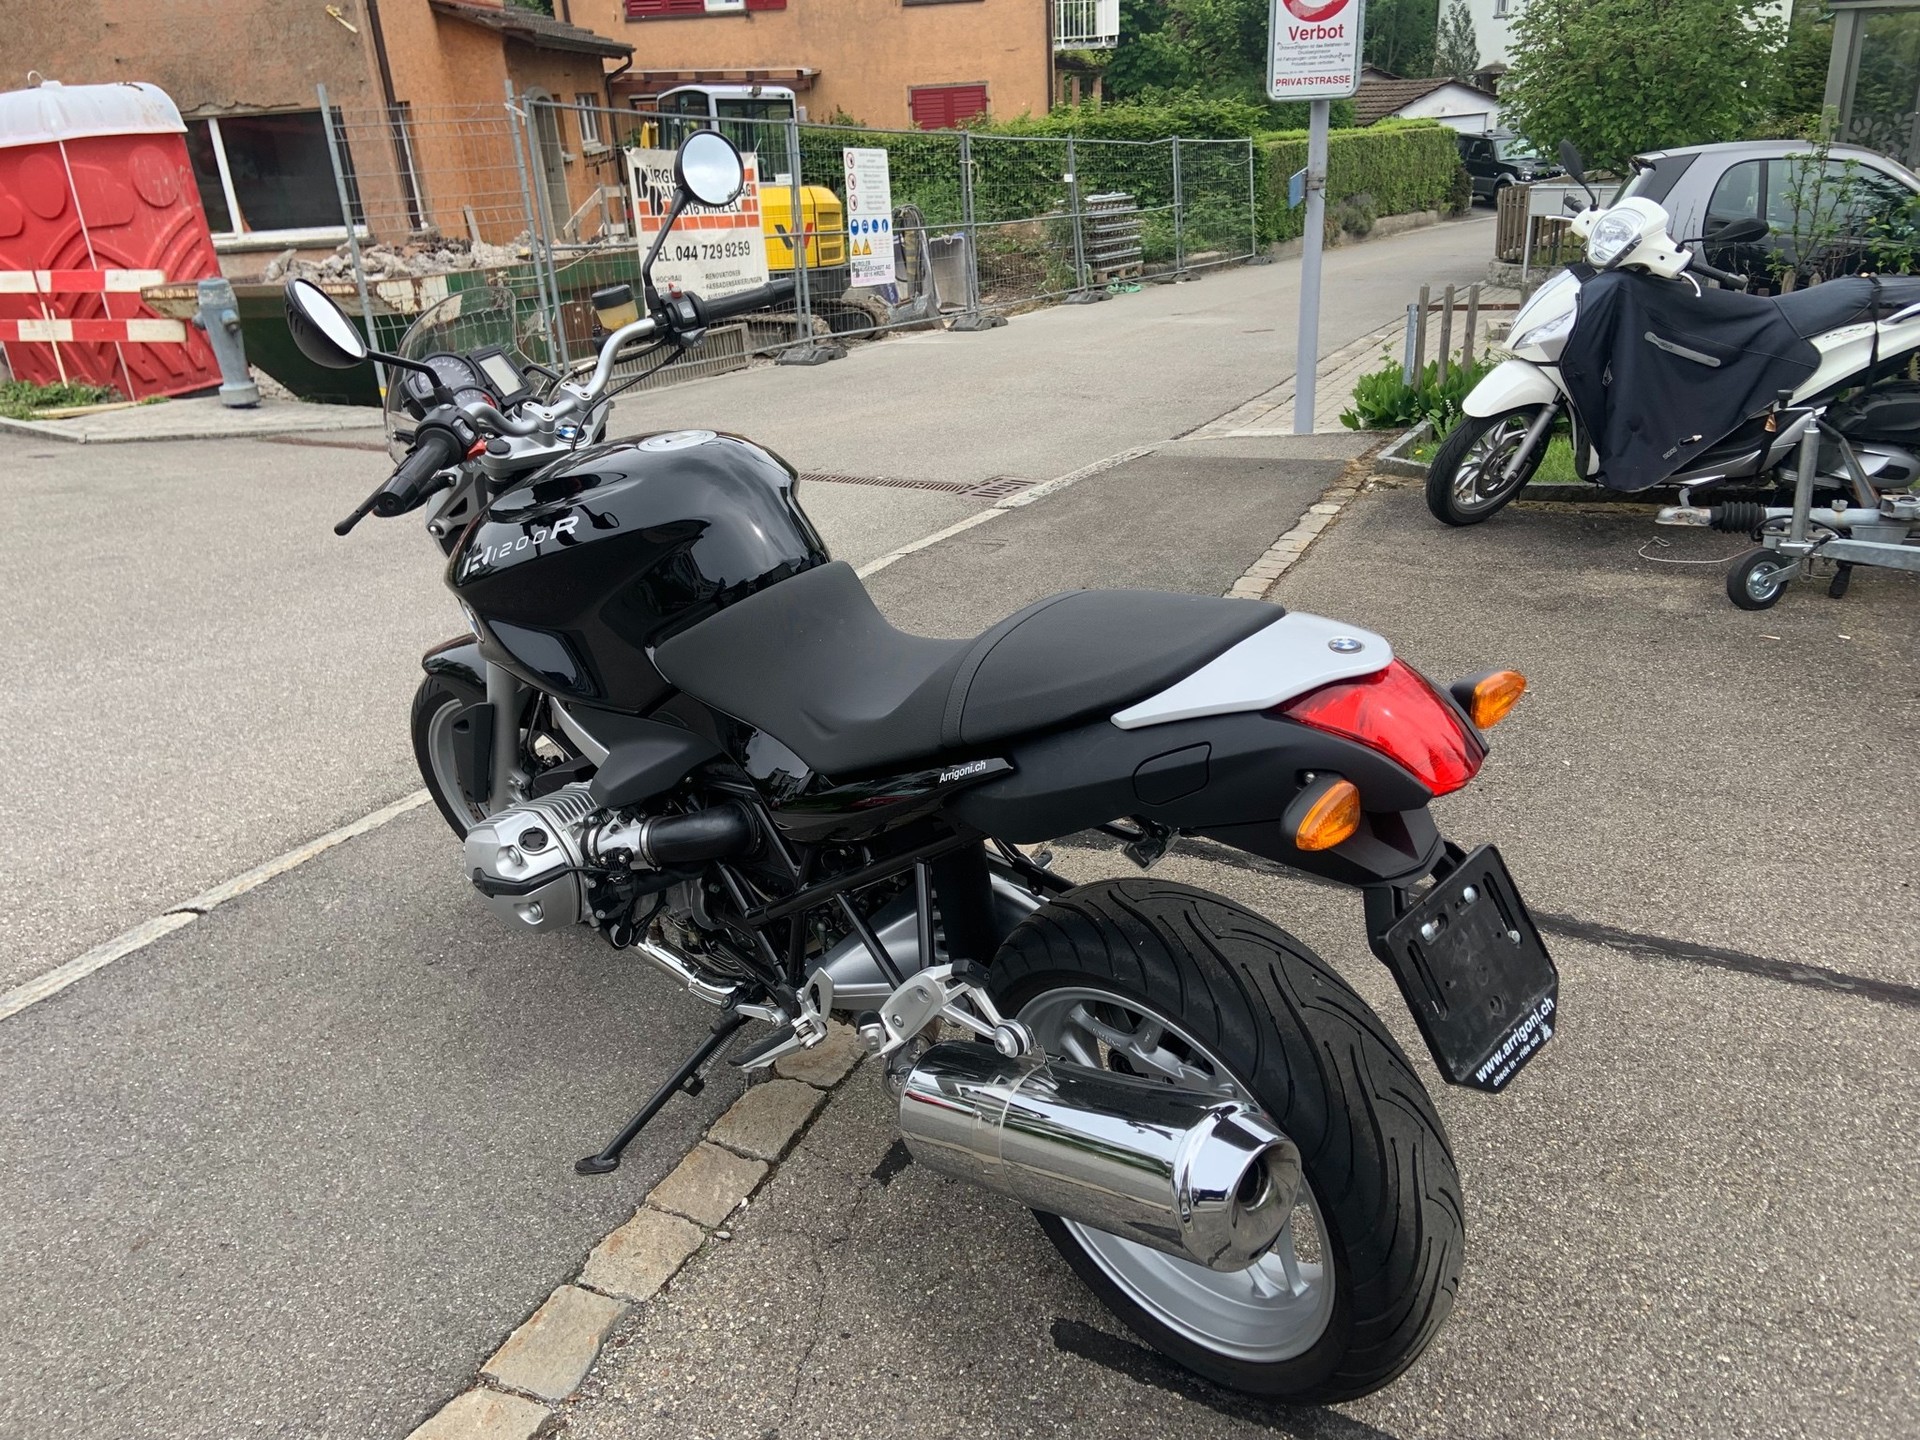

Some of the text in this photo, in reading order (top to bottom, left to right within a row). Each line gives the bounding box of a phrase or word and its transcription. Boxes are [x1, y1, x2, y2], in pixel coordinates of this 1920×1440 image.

[1288, 23, 1344, 41] Verbot
[1275, 75, 1351, 87] PRIVATSTRASSE
[676, 246, 698, 261] 044
[702, 244, 722, 260] 729
[725, 241, 751, 258] 9259
[939, 760, 987, 783] Arrigoni.ch
[1475, 997, 1555, 1083] www.arrigoni.ch
[1493, 1066, 1510, 1086] check
[1508, 1061, 1517, 1070] in
[1519, 1044, 1531, 1059] ride
[1530, 1033, 1541, 1047] out
